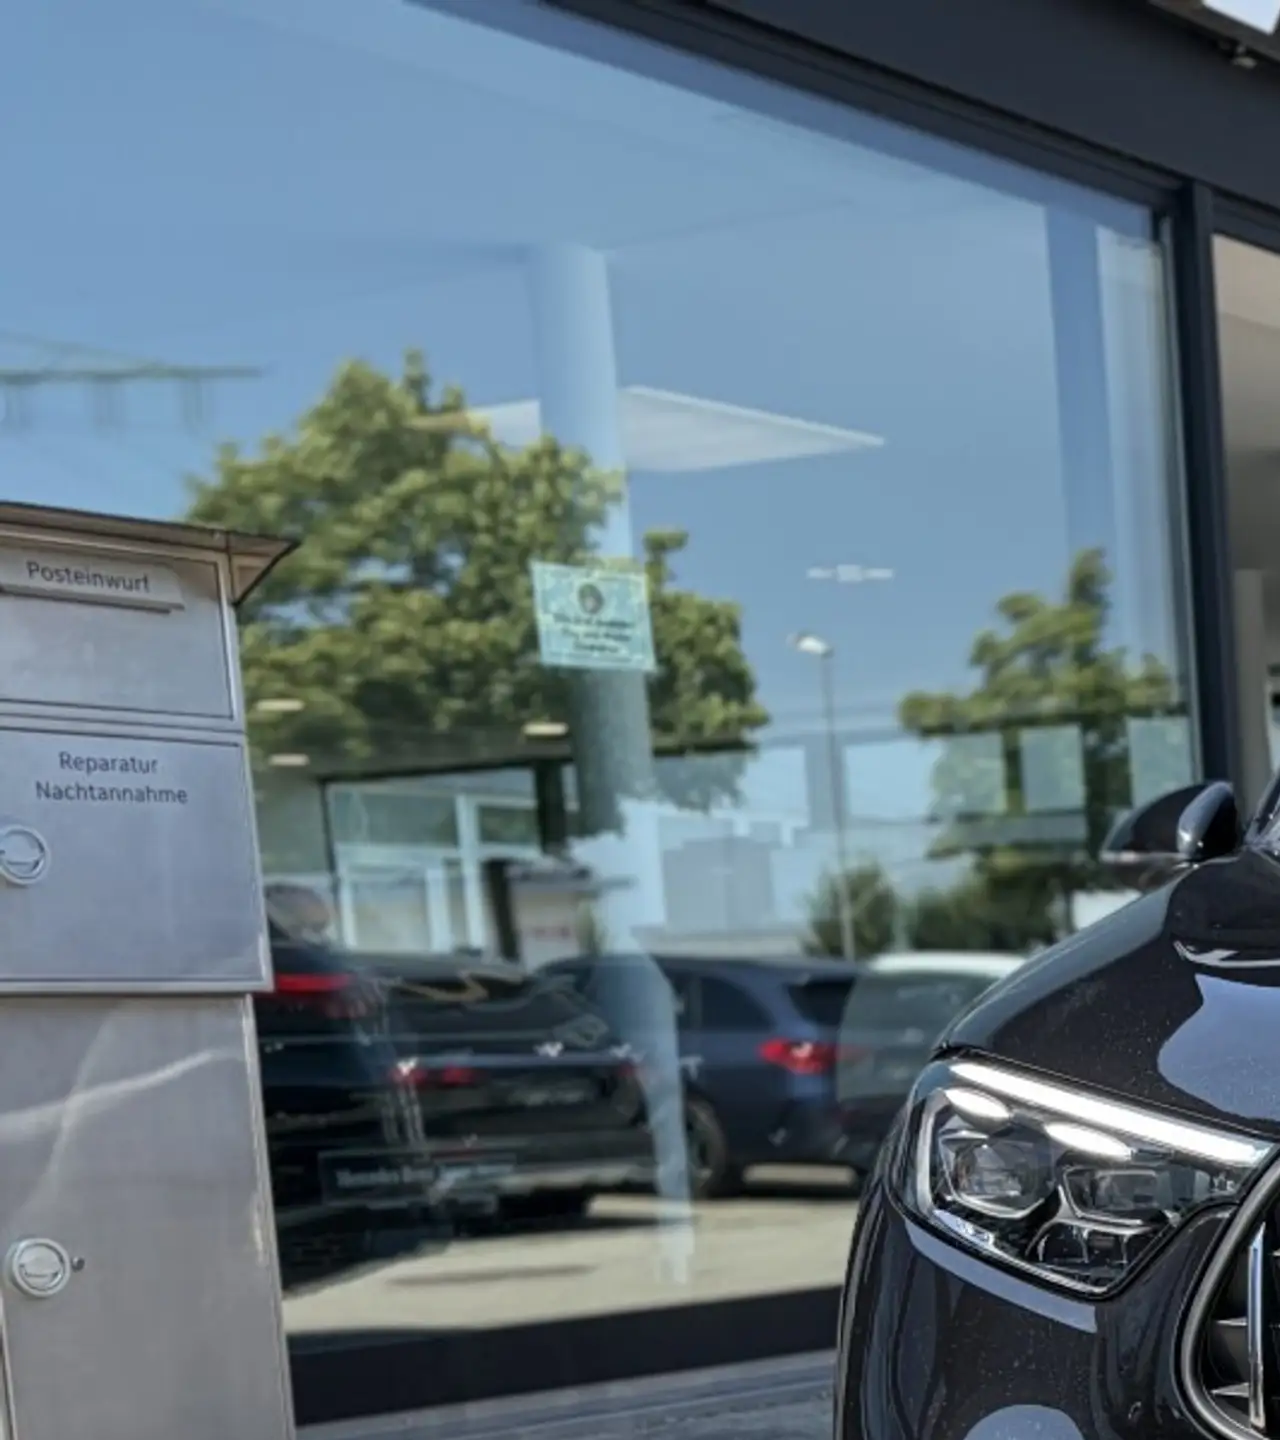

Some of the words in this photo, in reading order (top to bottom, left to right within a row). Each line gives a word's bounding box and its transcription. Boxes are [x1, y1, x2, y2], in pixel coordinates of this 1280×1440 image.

[26, 560, 150, 593] Posteinwurf
[58, 751, 158, 775] Reparatur
[35, 780, 188, 804] Nachtannahme
